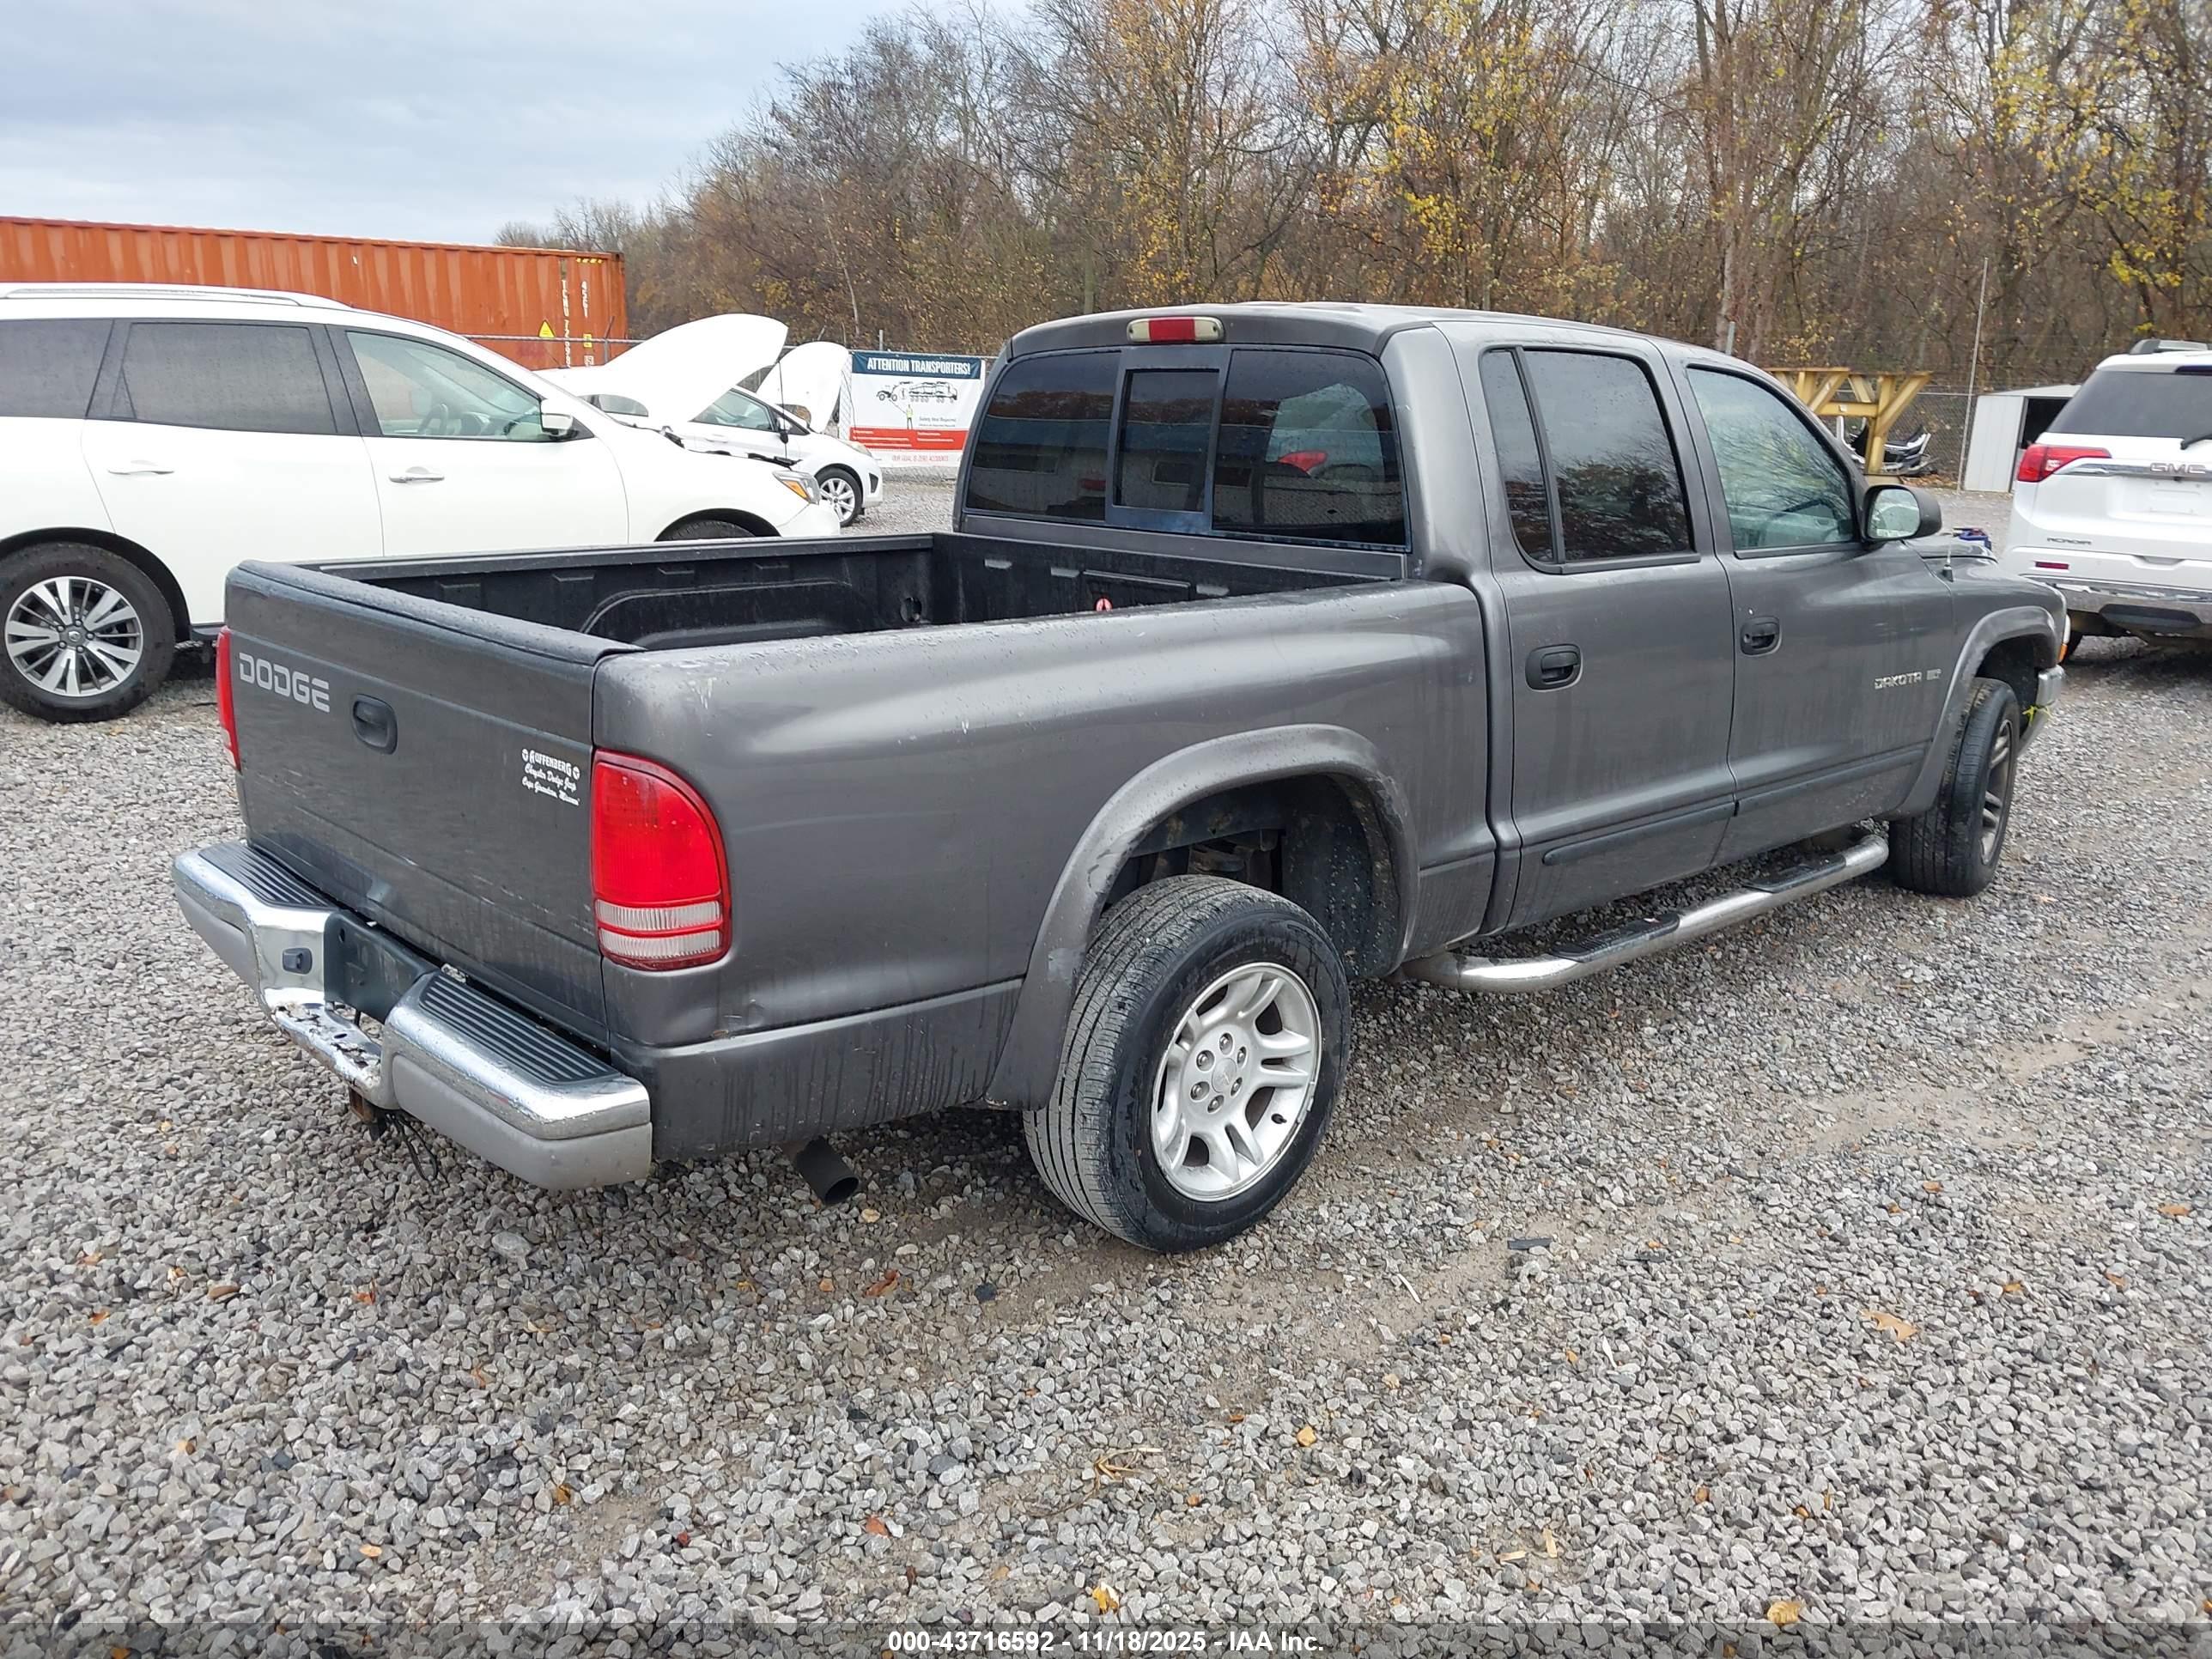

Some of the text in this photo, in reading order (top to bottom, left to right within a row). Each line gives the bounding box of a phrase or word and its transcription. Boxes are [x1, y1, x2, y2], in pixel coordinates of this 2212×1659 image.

[866, 356, 971, 375] ATTENTION TRANSPORTERS!
[2149, 462, 2206, 474] GMC
[239, 652, 331, 714] DODGE
[1875, 672, 1923, 690] DAKOTA
